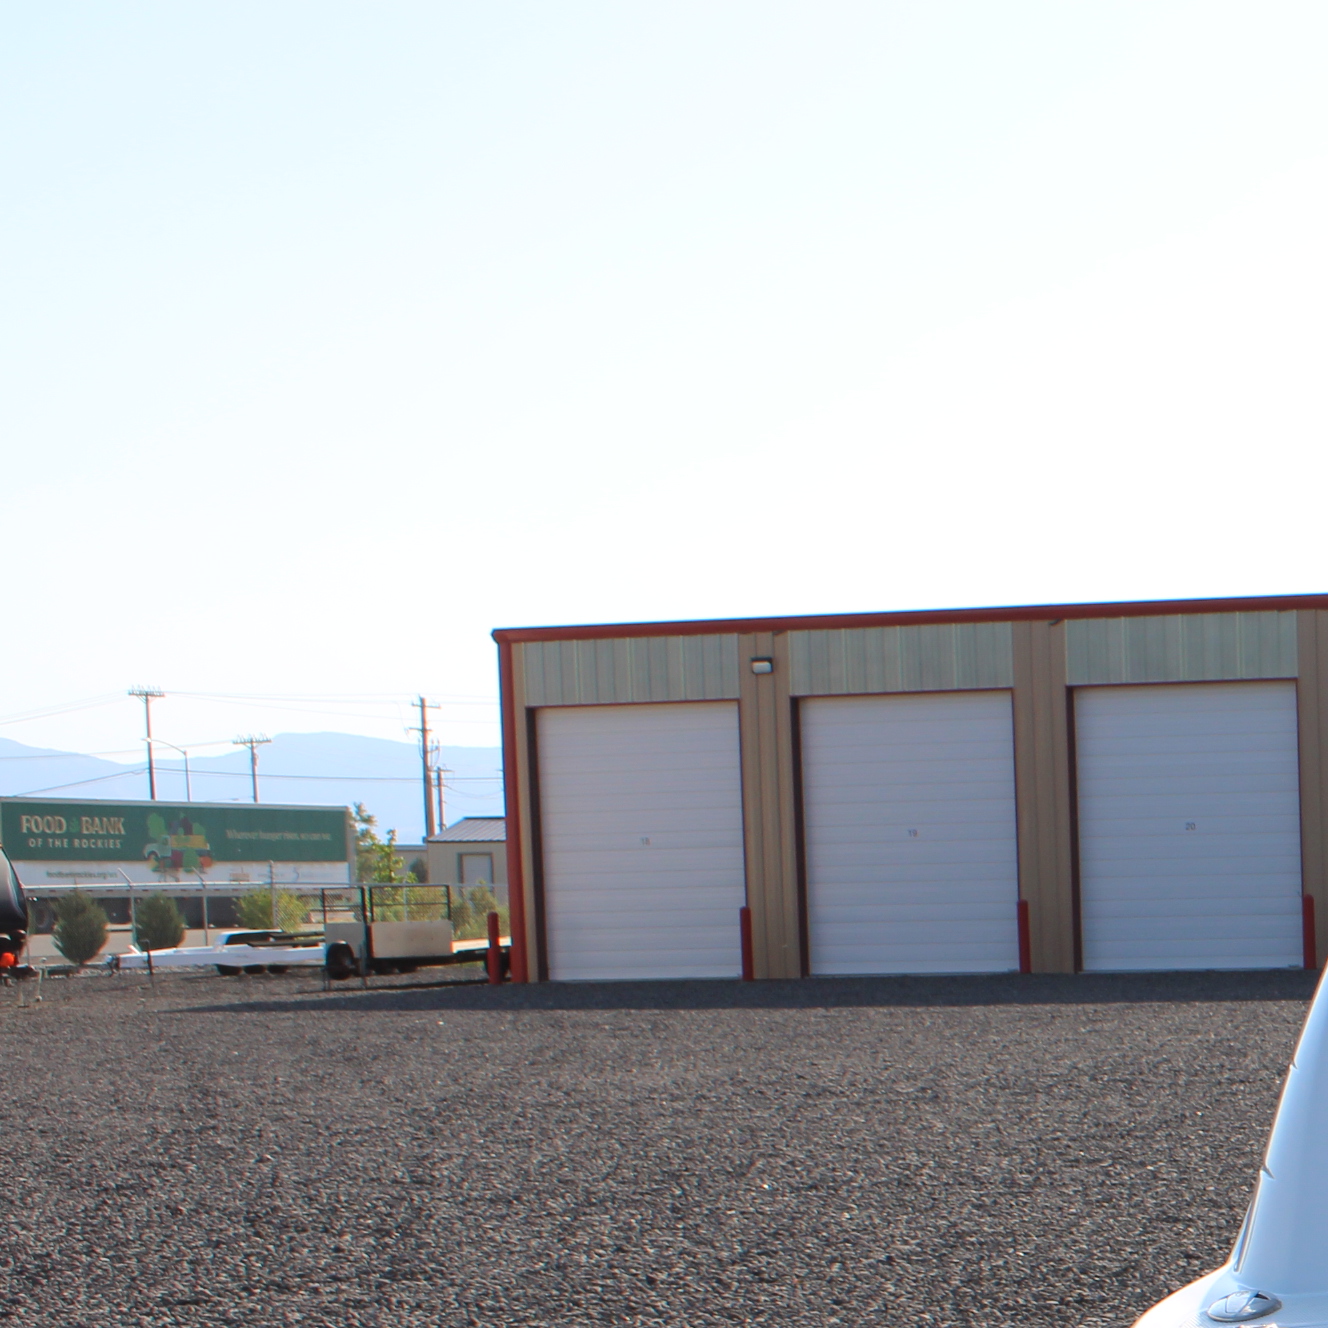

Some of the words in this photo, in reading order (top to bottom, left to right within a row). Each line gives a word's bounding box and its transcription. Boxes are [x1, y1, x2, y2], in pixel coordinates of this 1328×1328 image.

[21, 815, 66, 834] FOOD
[80, 816, 126, 835] BANK
[28, 838, 45, 848] OF
[48, 838, 69, 848] THE
[72, 839, 122, 849] ROCKIES
